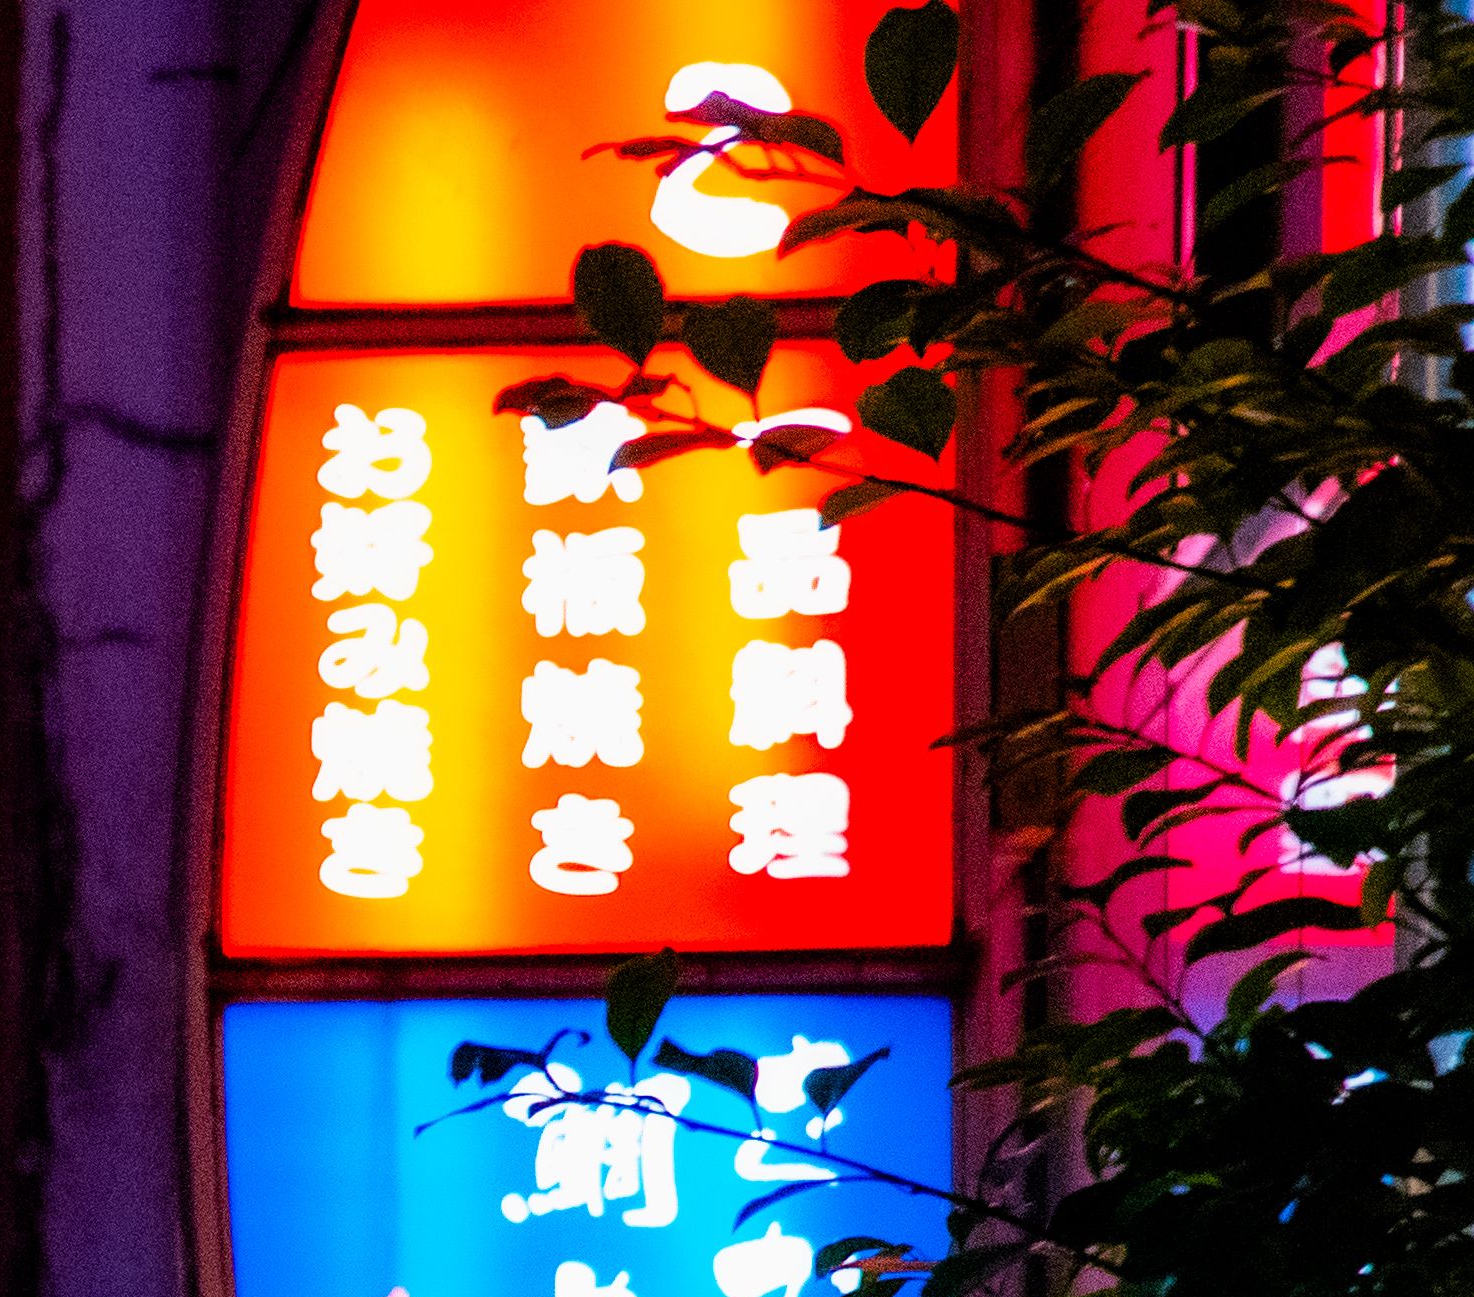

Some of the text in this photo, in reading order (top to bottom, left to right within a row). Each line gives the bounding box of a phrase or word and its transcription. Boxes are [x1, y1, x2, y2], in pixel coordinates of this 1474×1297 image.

[310, 402, 435, 899] お好み焼き
